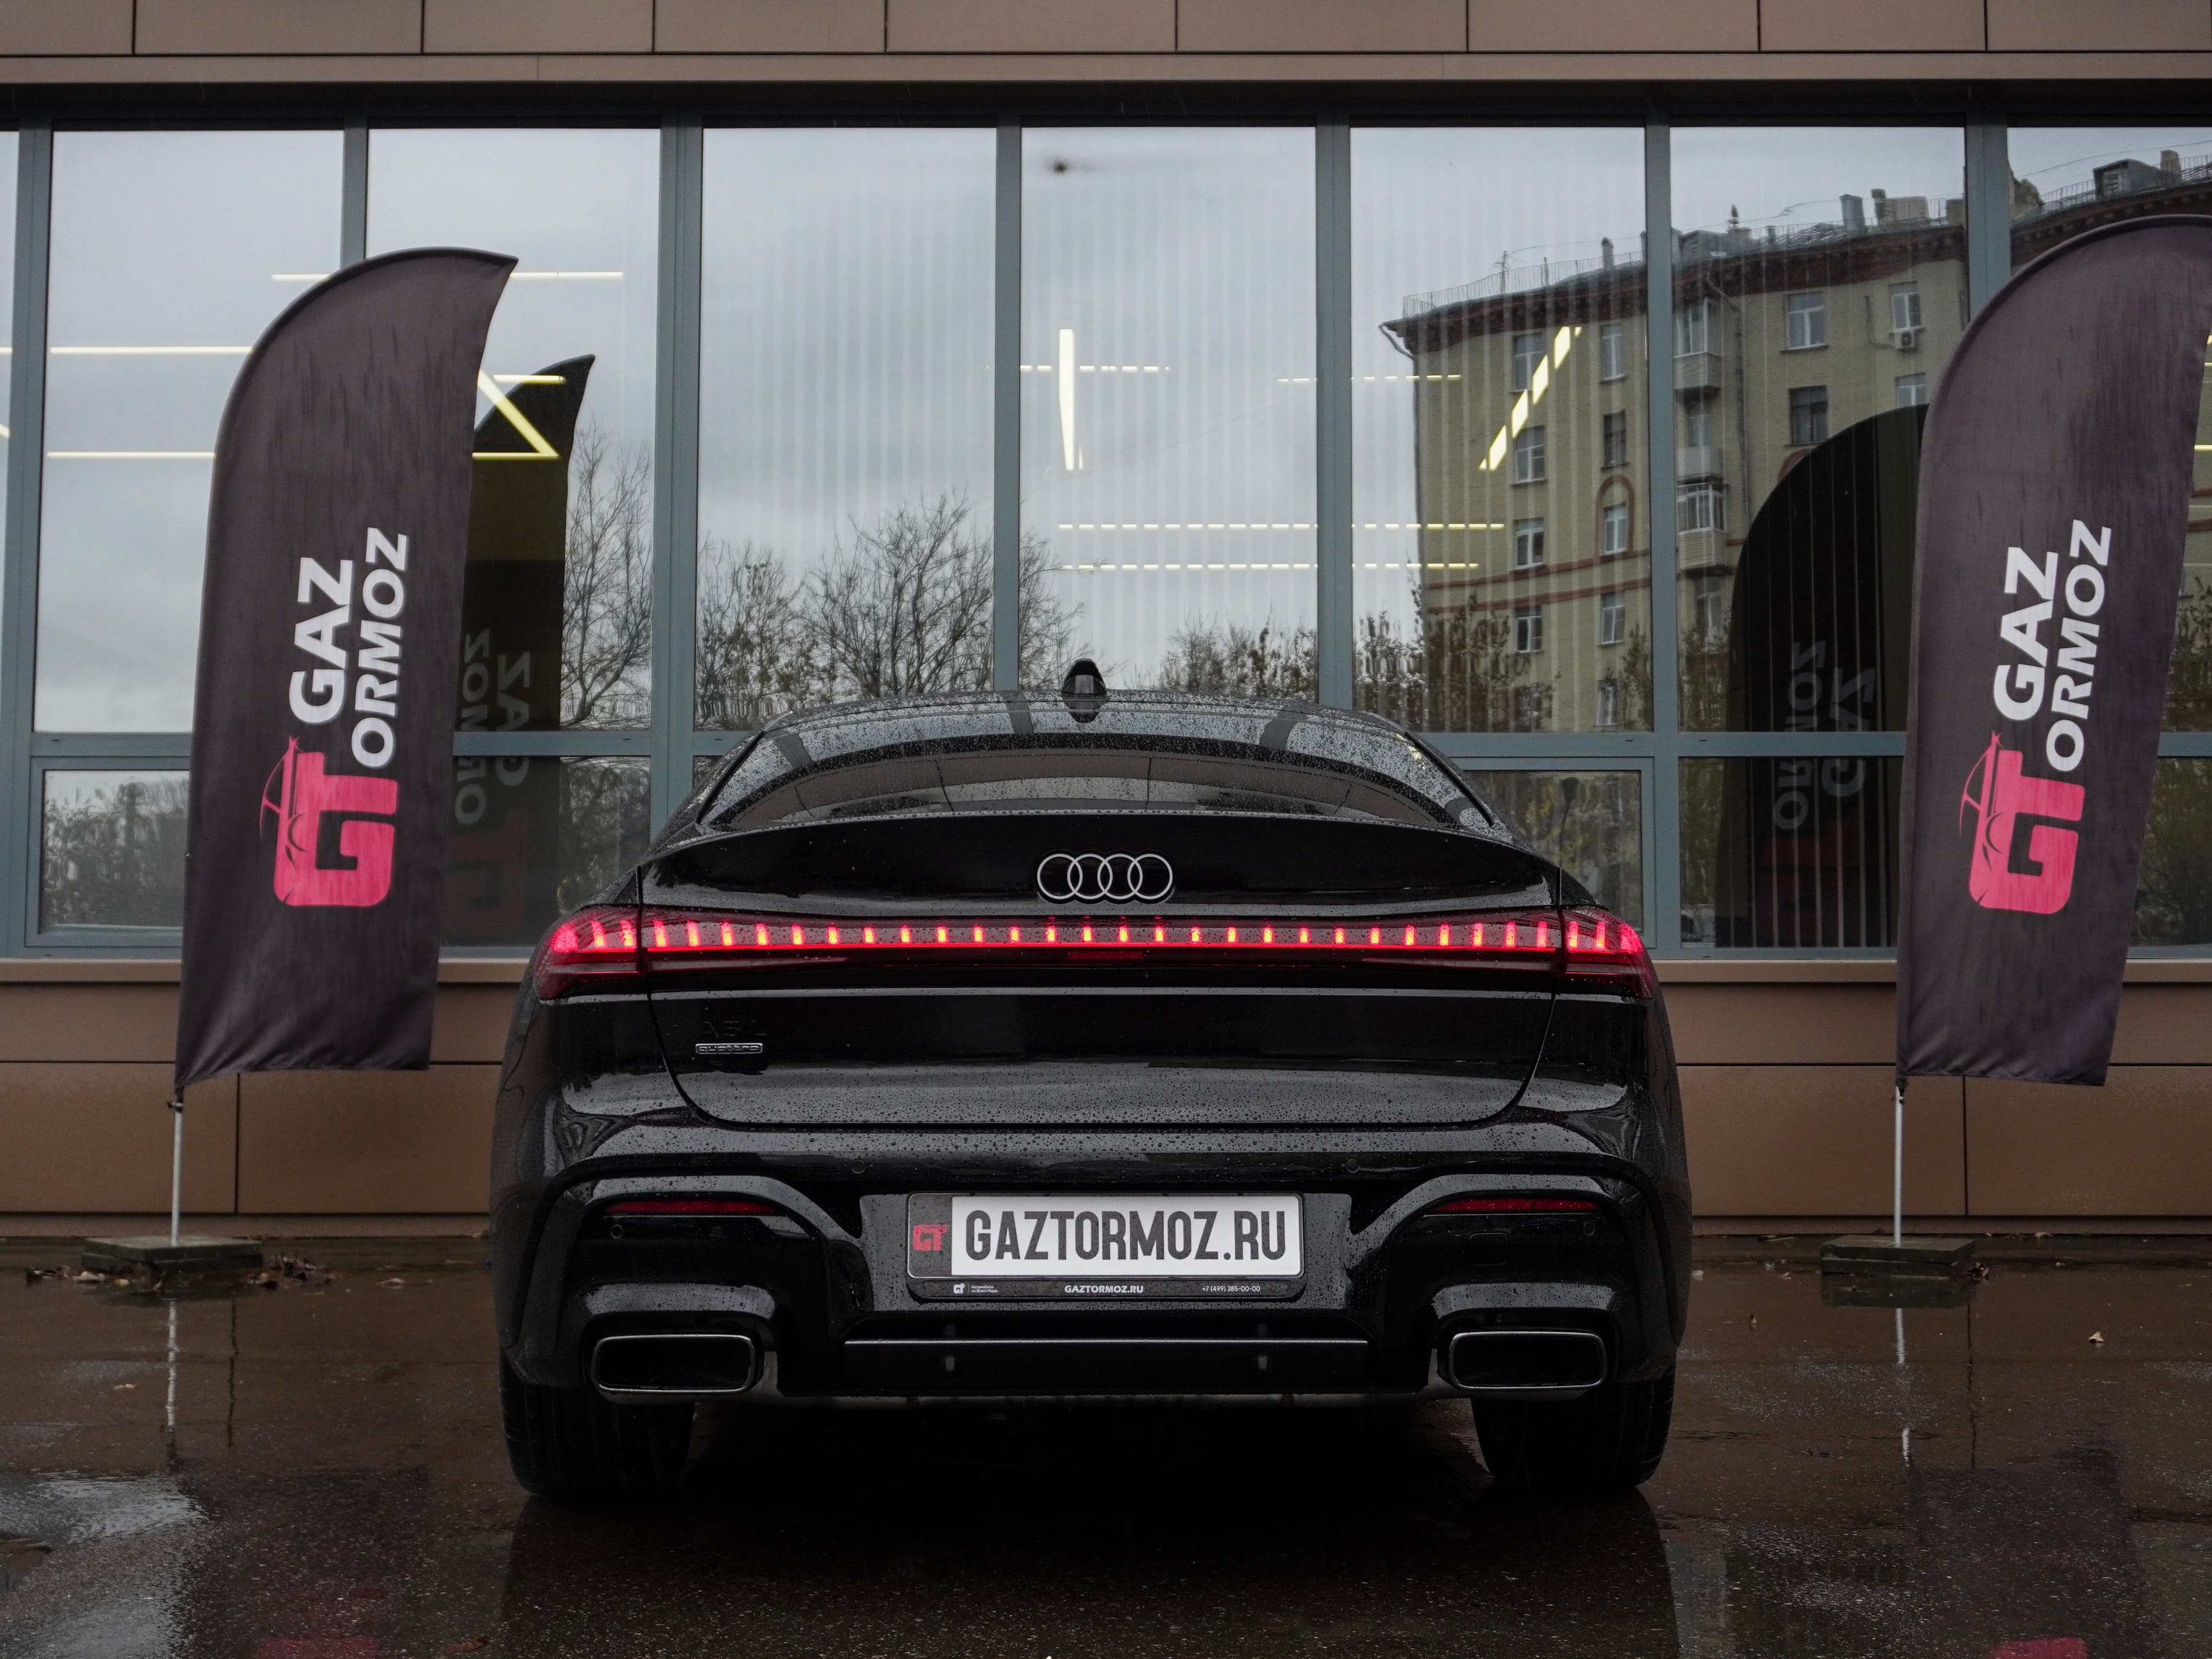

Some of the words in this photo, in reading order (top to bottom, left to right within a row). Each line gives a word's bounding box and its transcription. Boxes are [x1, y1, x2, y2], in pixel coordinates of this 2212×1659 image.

[289, 557, 353, 723] GAZ
[351, 528, 408, 767] ORMOZ
[1993, 547, 2058, 721] GAZ
[2045, 519, 2112, 772] ORMOZ
[266, 742, 398, 906] GT
[1963, 737, 2086, 915] GT
[912, 1224, 949, 1251] GT
[965, 1210, 1286, 1261] GAZTORMOZ.RU
[1064, 1285, 1144, 1293] GAZTORMOZ.RU
